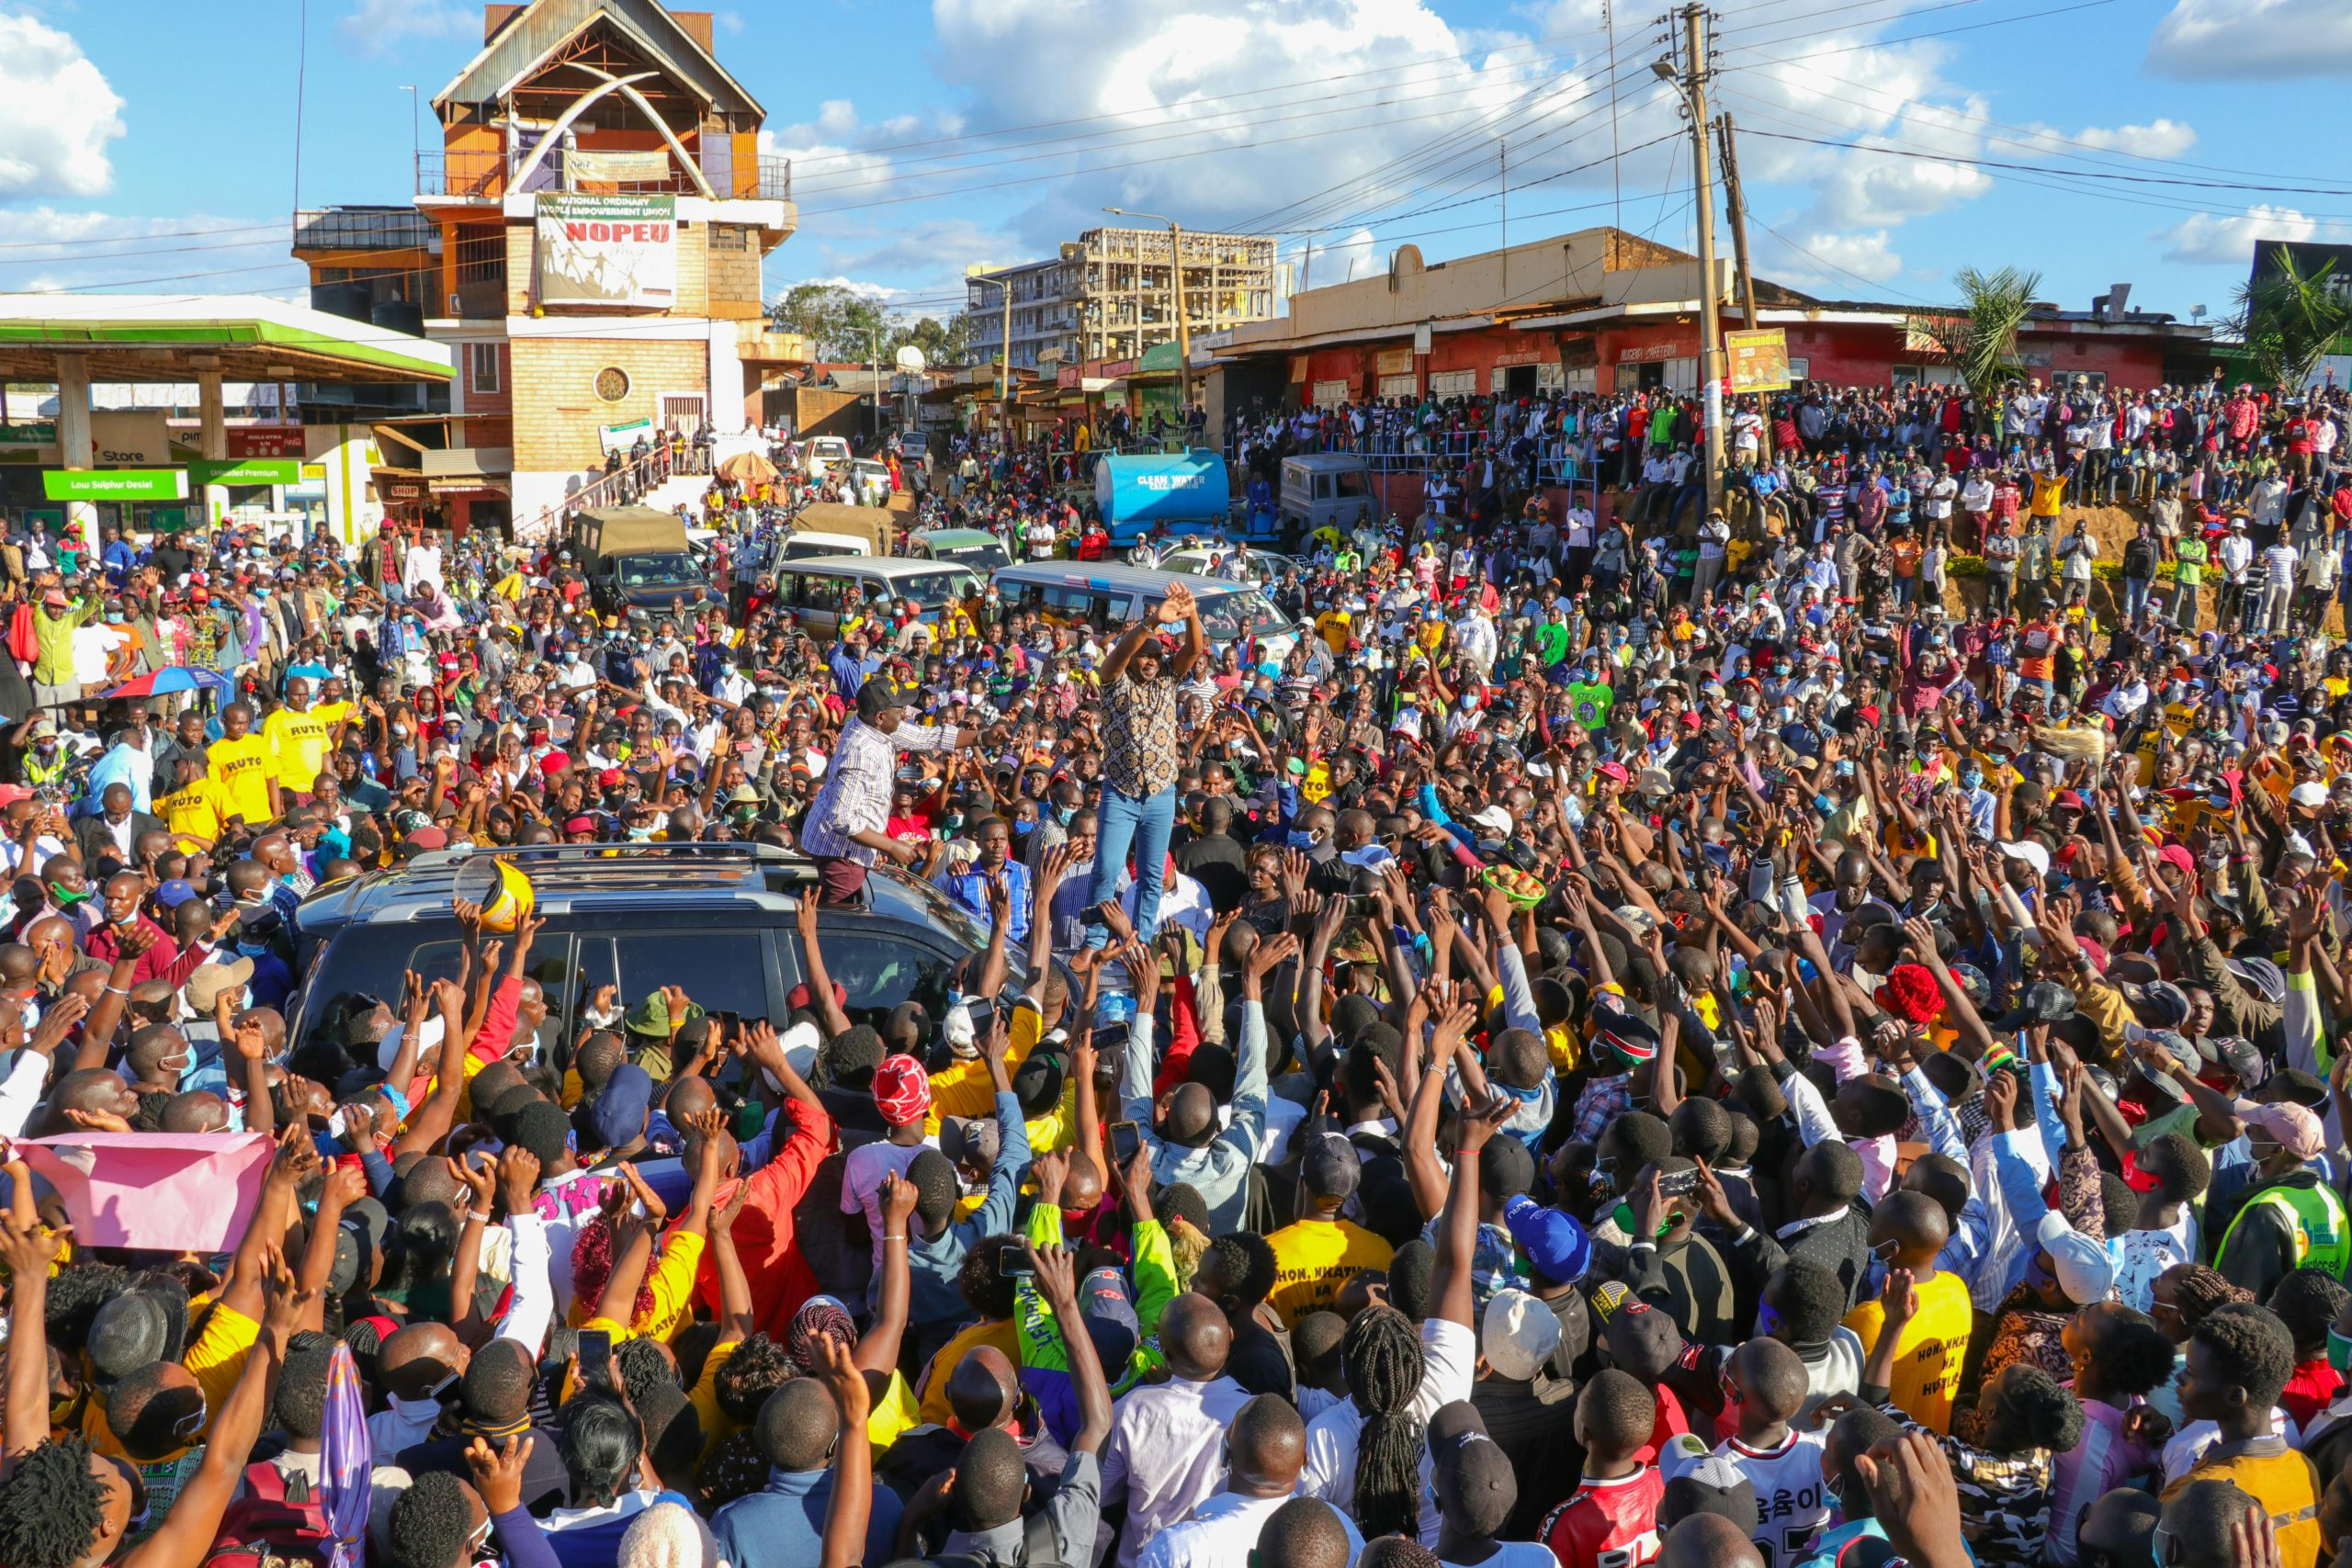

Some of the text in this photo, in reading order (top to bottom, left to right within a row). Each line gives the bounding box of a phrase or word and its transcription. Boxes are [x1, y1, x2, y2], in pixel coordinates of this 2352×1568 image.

[557, 197, 650, 206] NATIONAL ORDINARY
[538, 205, 671, 216] PEOPLE EMPOWERMENT UNION
[566, 222, 670, 243] NOPEU
[1732, 334, 1785, 348] Commanding
[1645, 343, 1677, 359] CAFETERIA
[102, 450, 144, 461] Store
[71, 480, 153, 491] Low Sulphur Desiel
[1137, 475, 1205, 485] CLEAN WATER
[391, 487, 417, 495] SHOP
[2165, 712, 2192, 725] RUTO
[290, 725, 324, 736] RUTO
[225, 756, 262, 773] RUTO
[1306, 781, 1325, 792] TO
[171, 795, 203, 808] RUTO
[1277, 1267, 1362, 1282] HON. NKATH
[1594, 1292, 1614, 1316] SPORTS
[1917, 1342, 1943, 1363] HON.
